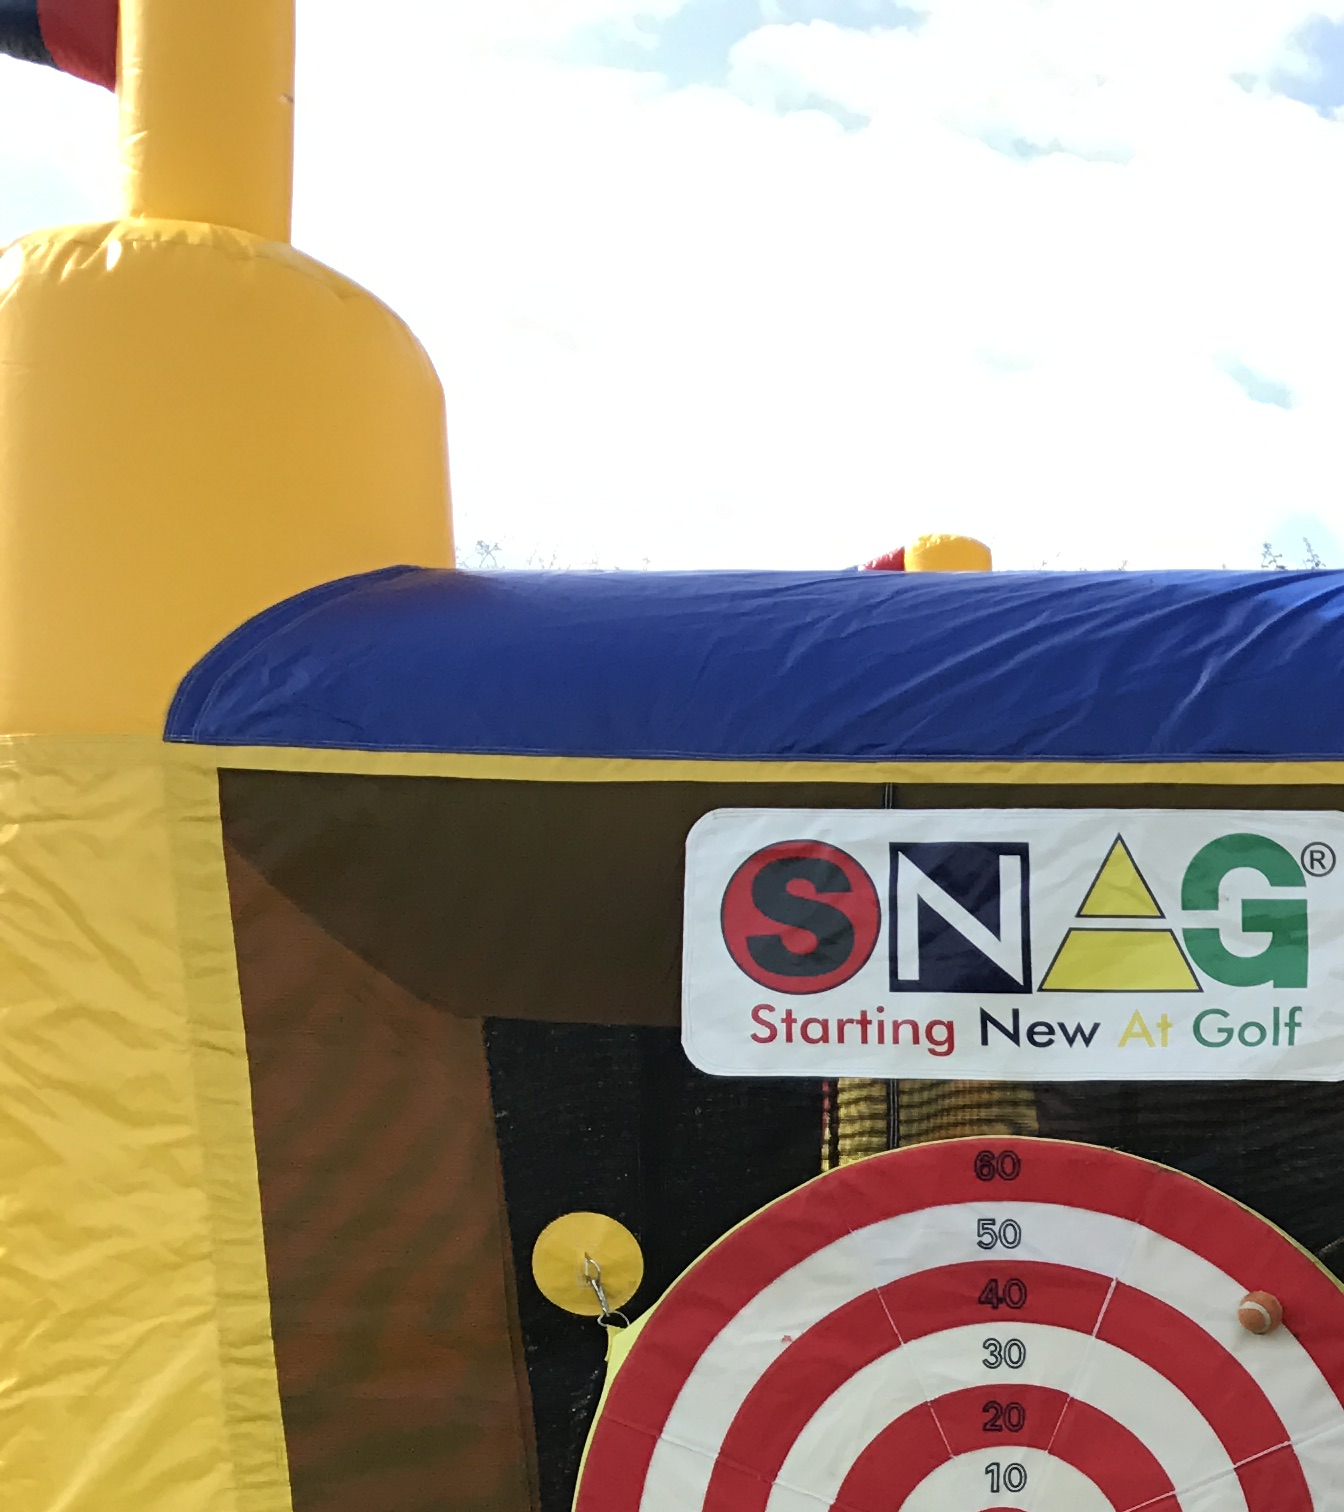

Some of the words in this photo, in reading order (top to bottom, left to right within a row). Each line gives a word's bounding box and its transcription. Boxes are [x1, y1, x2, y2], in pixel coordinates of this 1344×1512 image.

[750, 1003, 956, 1057] Starting
[980, 1007, 1101, 1048] New
[1117, 1008, 1173, 1049] At
[1192, 1005, 1304, 1049] Golf
[974, 1150, 1021, 1181] 60
[976, 1218, 1022, 1250] 50
[978, 1278, 1028, 1310] 40
[982, 1337, 1027, 1369] 30
[982, 1401, 1026, 1432] 20
[984, 1462, 1028, 1493] 10
